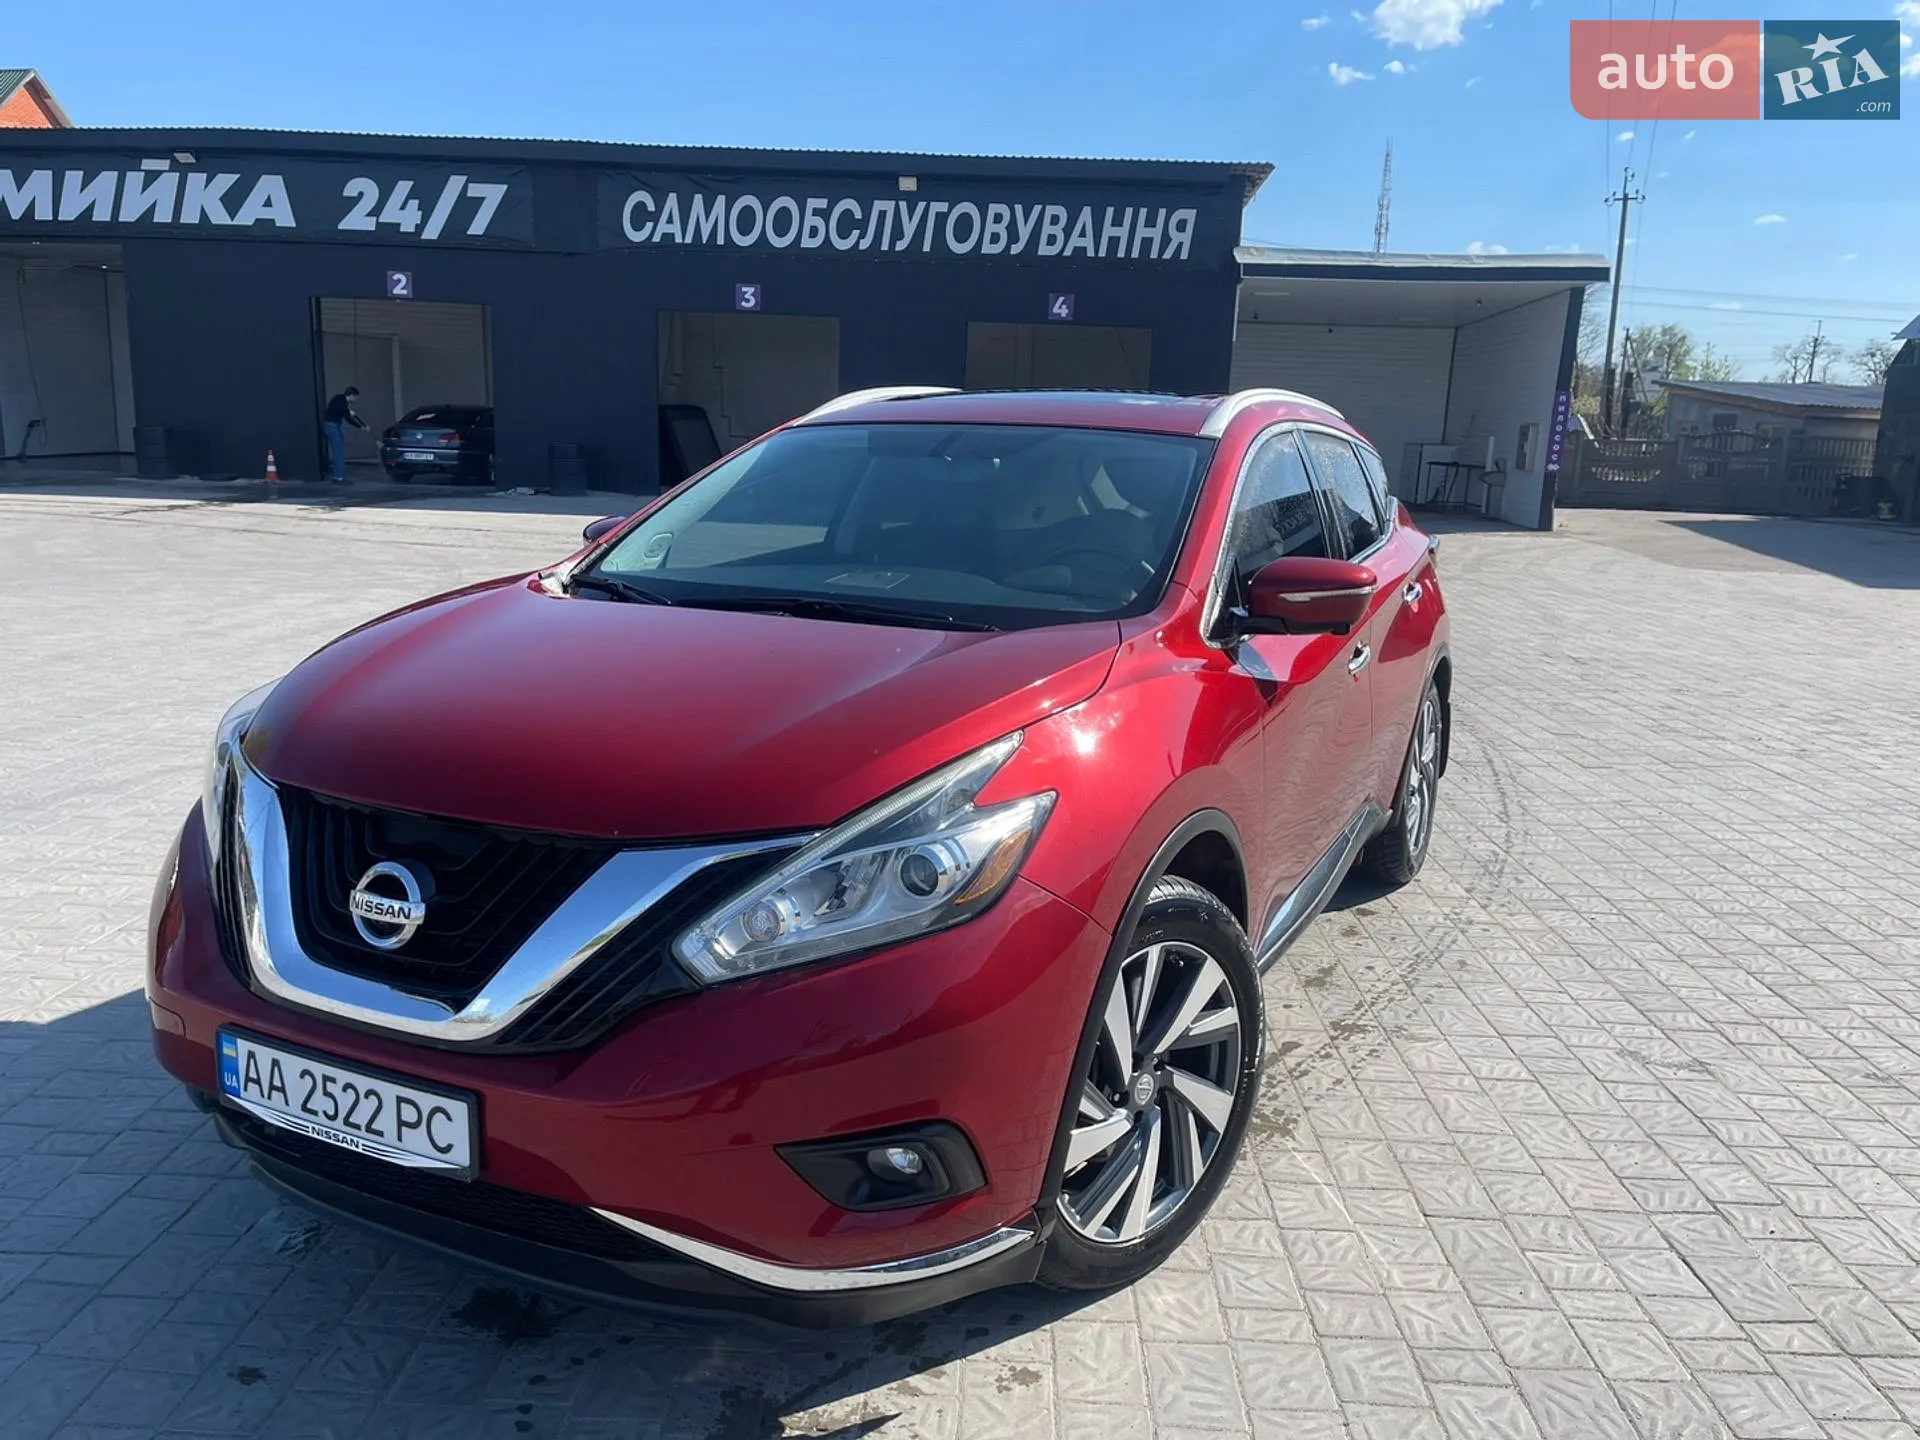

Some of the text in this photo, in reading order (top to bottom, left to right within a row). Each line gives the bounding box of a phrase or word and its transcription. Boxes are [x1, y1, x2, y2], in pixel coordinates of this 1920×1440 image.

[0, 159, 508, 240] МИЙКА 24/7
[622, 190, 1197, 260] САМООБСЛУГОВУВАННЯ
[392, 274, 408, 295] 2
[740, 287, 756, 309] 3
[1051, 296, 1069, 317] 4
[351, 894, 411, 920] NISSAN
[224, 1072, 239, 1090] UA
[243, 1050, 454, 1154] AA 2522 PC
[311, 1126, 361, 1149] NISSAN
